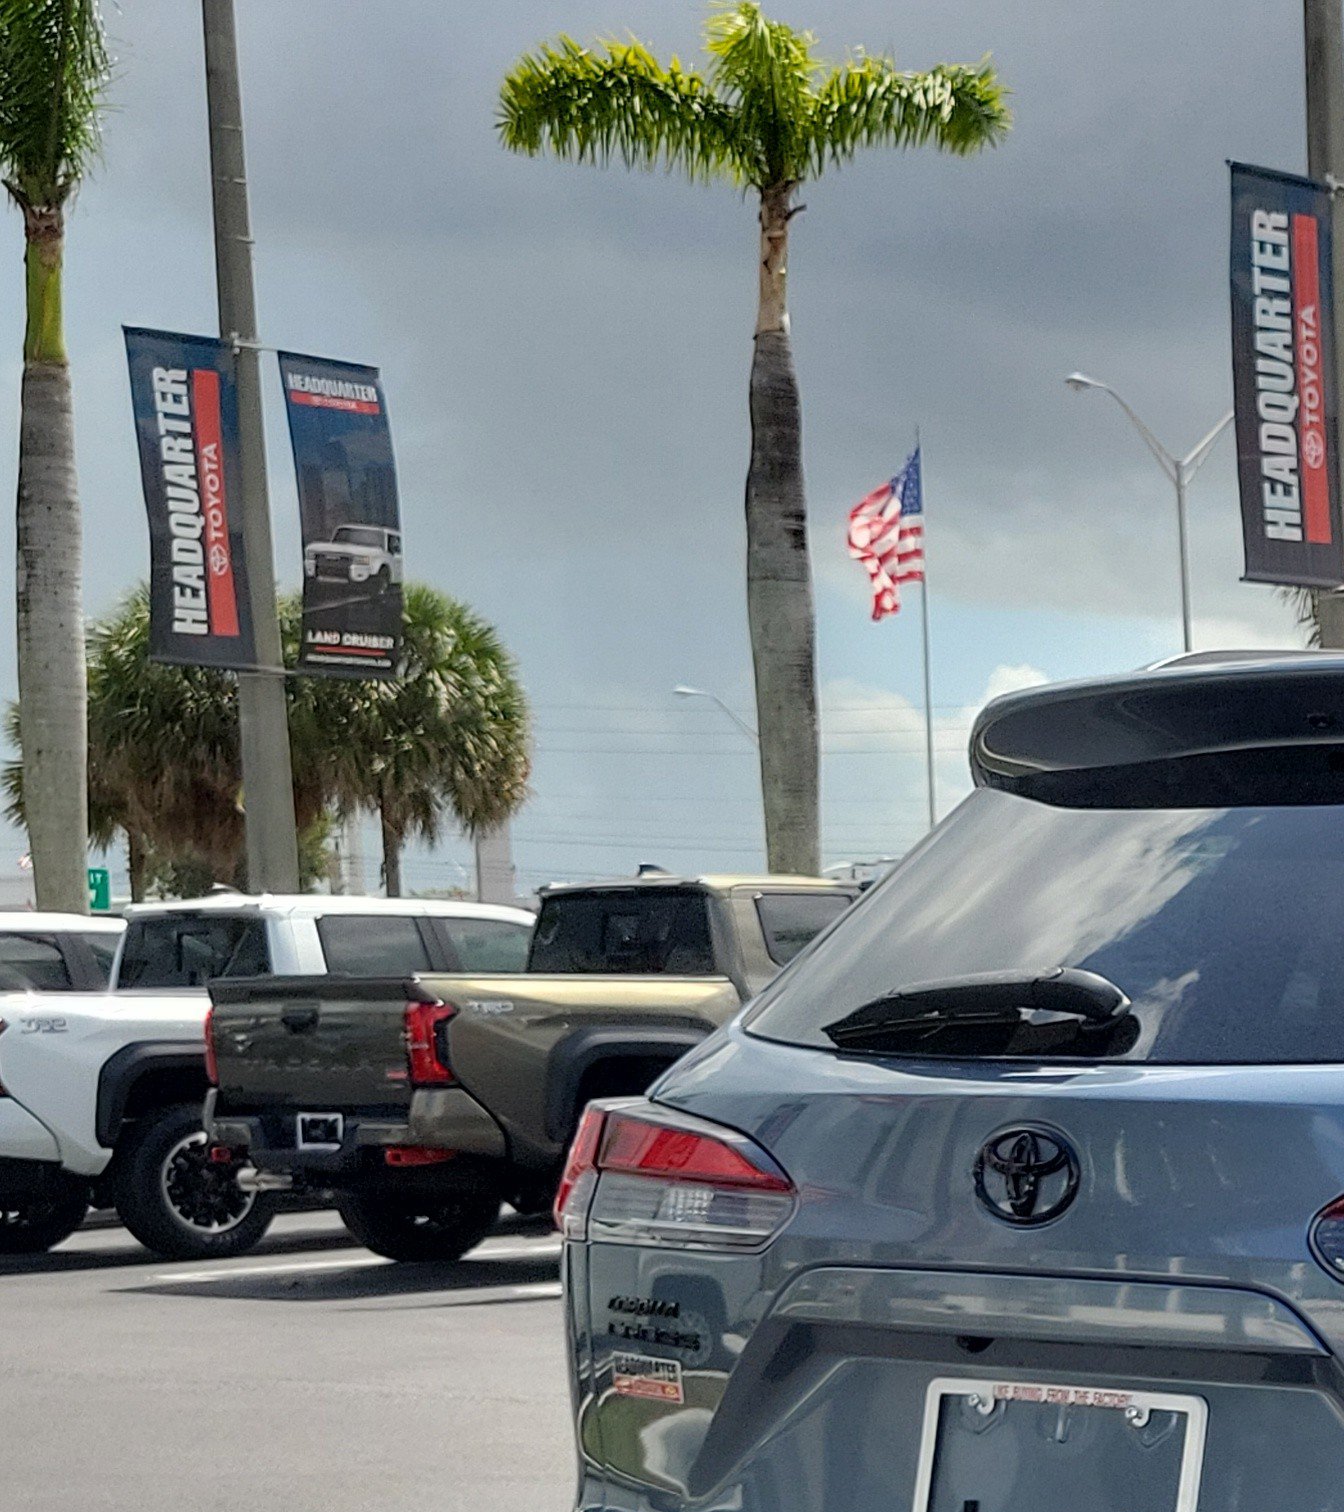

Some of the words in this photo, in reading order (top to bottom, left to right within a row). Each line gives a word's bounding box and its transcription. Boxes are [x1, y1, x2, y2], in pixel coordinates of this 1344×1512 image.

[287, 371, 378, 402] HEADQUARTER
[1251, 210, 1303, 542] HEADQUARTER
[1300, 304, 1320, 425] TOYOTA
[152, 366, 209, 636] HEADQUARTER
[202, 443, 224, 542] TOYOTA
